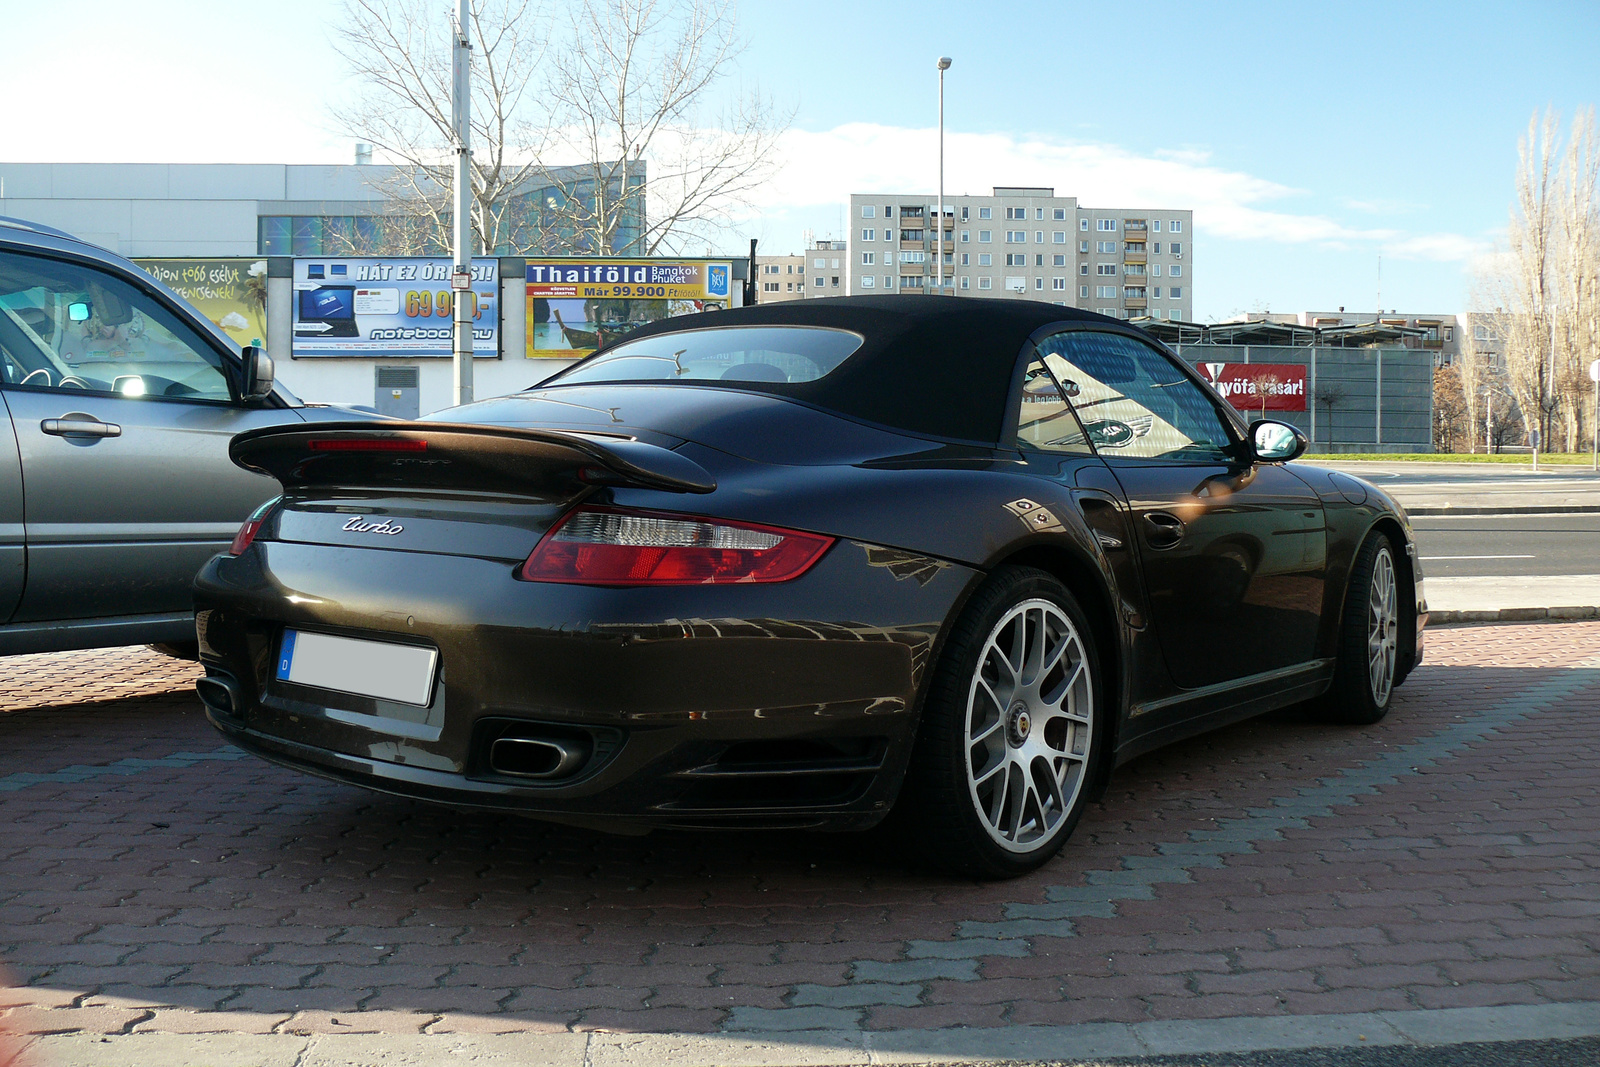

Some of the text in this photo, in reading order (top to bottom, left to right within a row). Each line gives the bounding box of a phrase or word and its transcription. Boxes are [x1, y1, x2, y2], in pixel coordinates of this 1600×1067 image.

[209, 265, 240, 285] esélyt
[357, 263, 393, 281] HÁT
[396, 265, 418, 281] EZ
[421, 262, 495, 281] ÓRISI!
[532, 266, 647, 284] Thaiföld
[651, 266, 698, 277] Bangkok
[651, 274, 686, 284] Phuket
[584, 287, 609, 297] Már
[612, 286, 665, 297] 99.900
[405, 290, 433, 318] 69
[436, 290, 489, 321] 9,-
[342, 516, 405, 536] turbo
[282, 659, 288, 671] D
